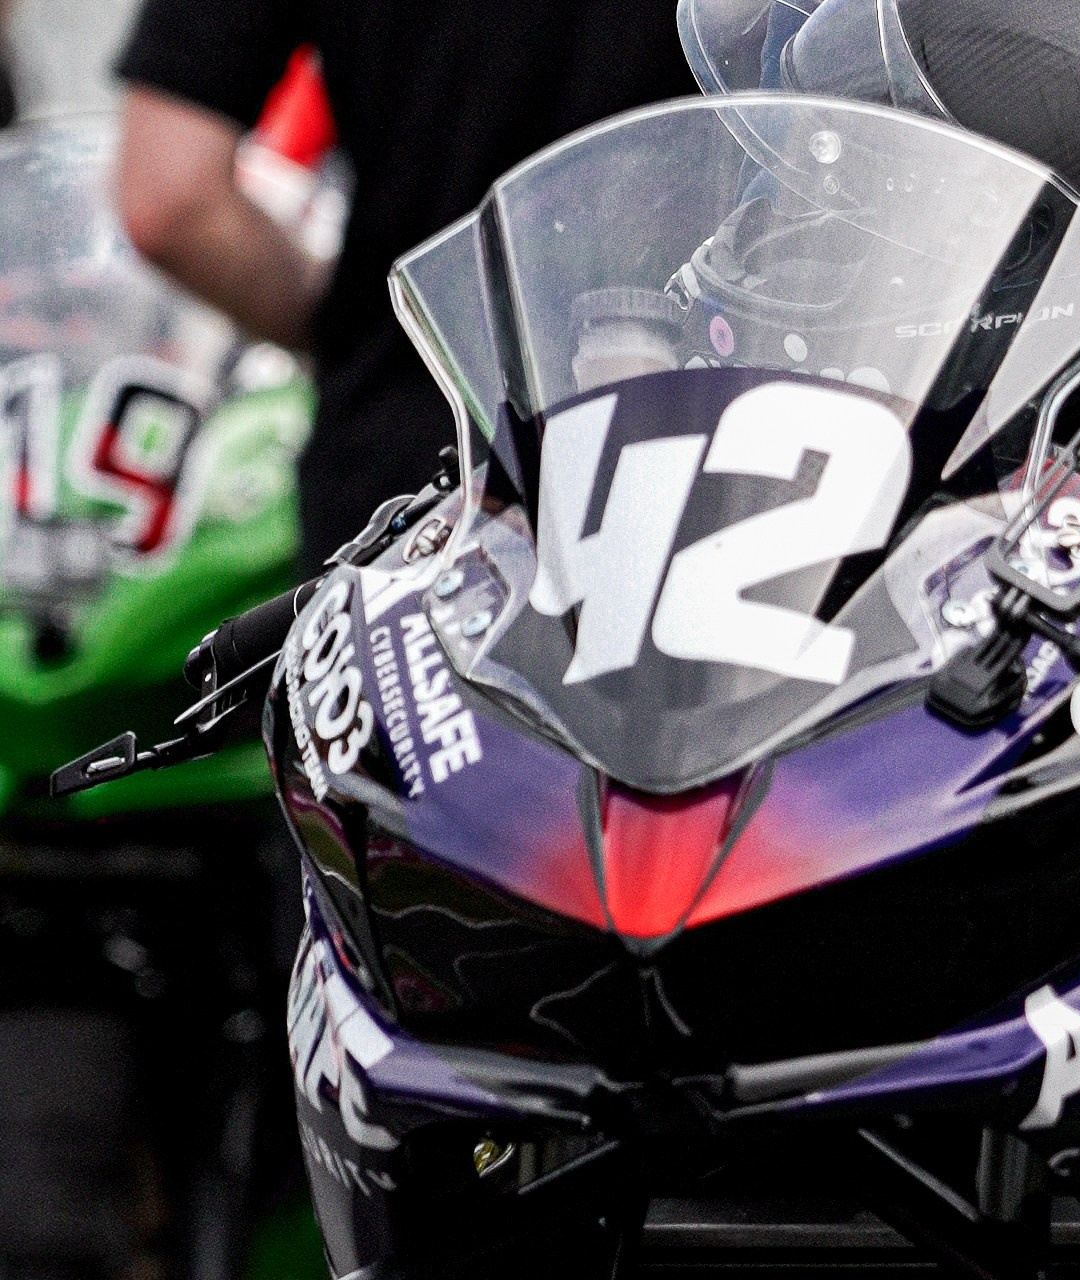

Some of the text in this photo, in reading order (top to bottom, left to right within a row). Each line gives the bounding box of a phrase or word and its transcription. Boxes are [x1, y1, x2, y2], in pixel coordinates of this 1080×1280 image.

[894, 303, 1075, 339] SCRPION
[529, 380, 914, 688] 42
[370, 625, 426, 799] CYBERSECURITY
[400, 612, 483, 784] ALLSAFE
